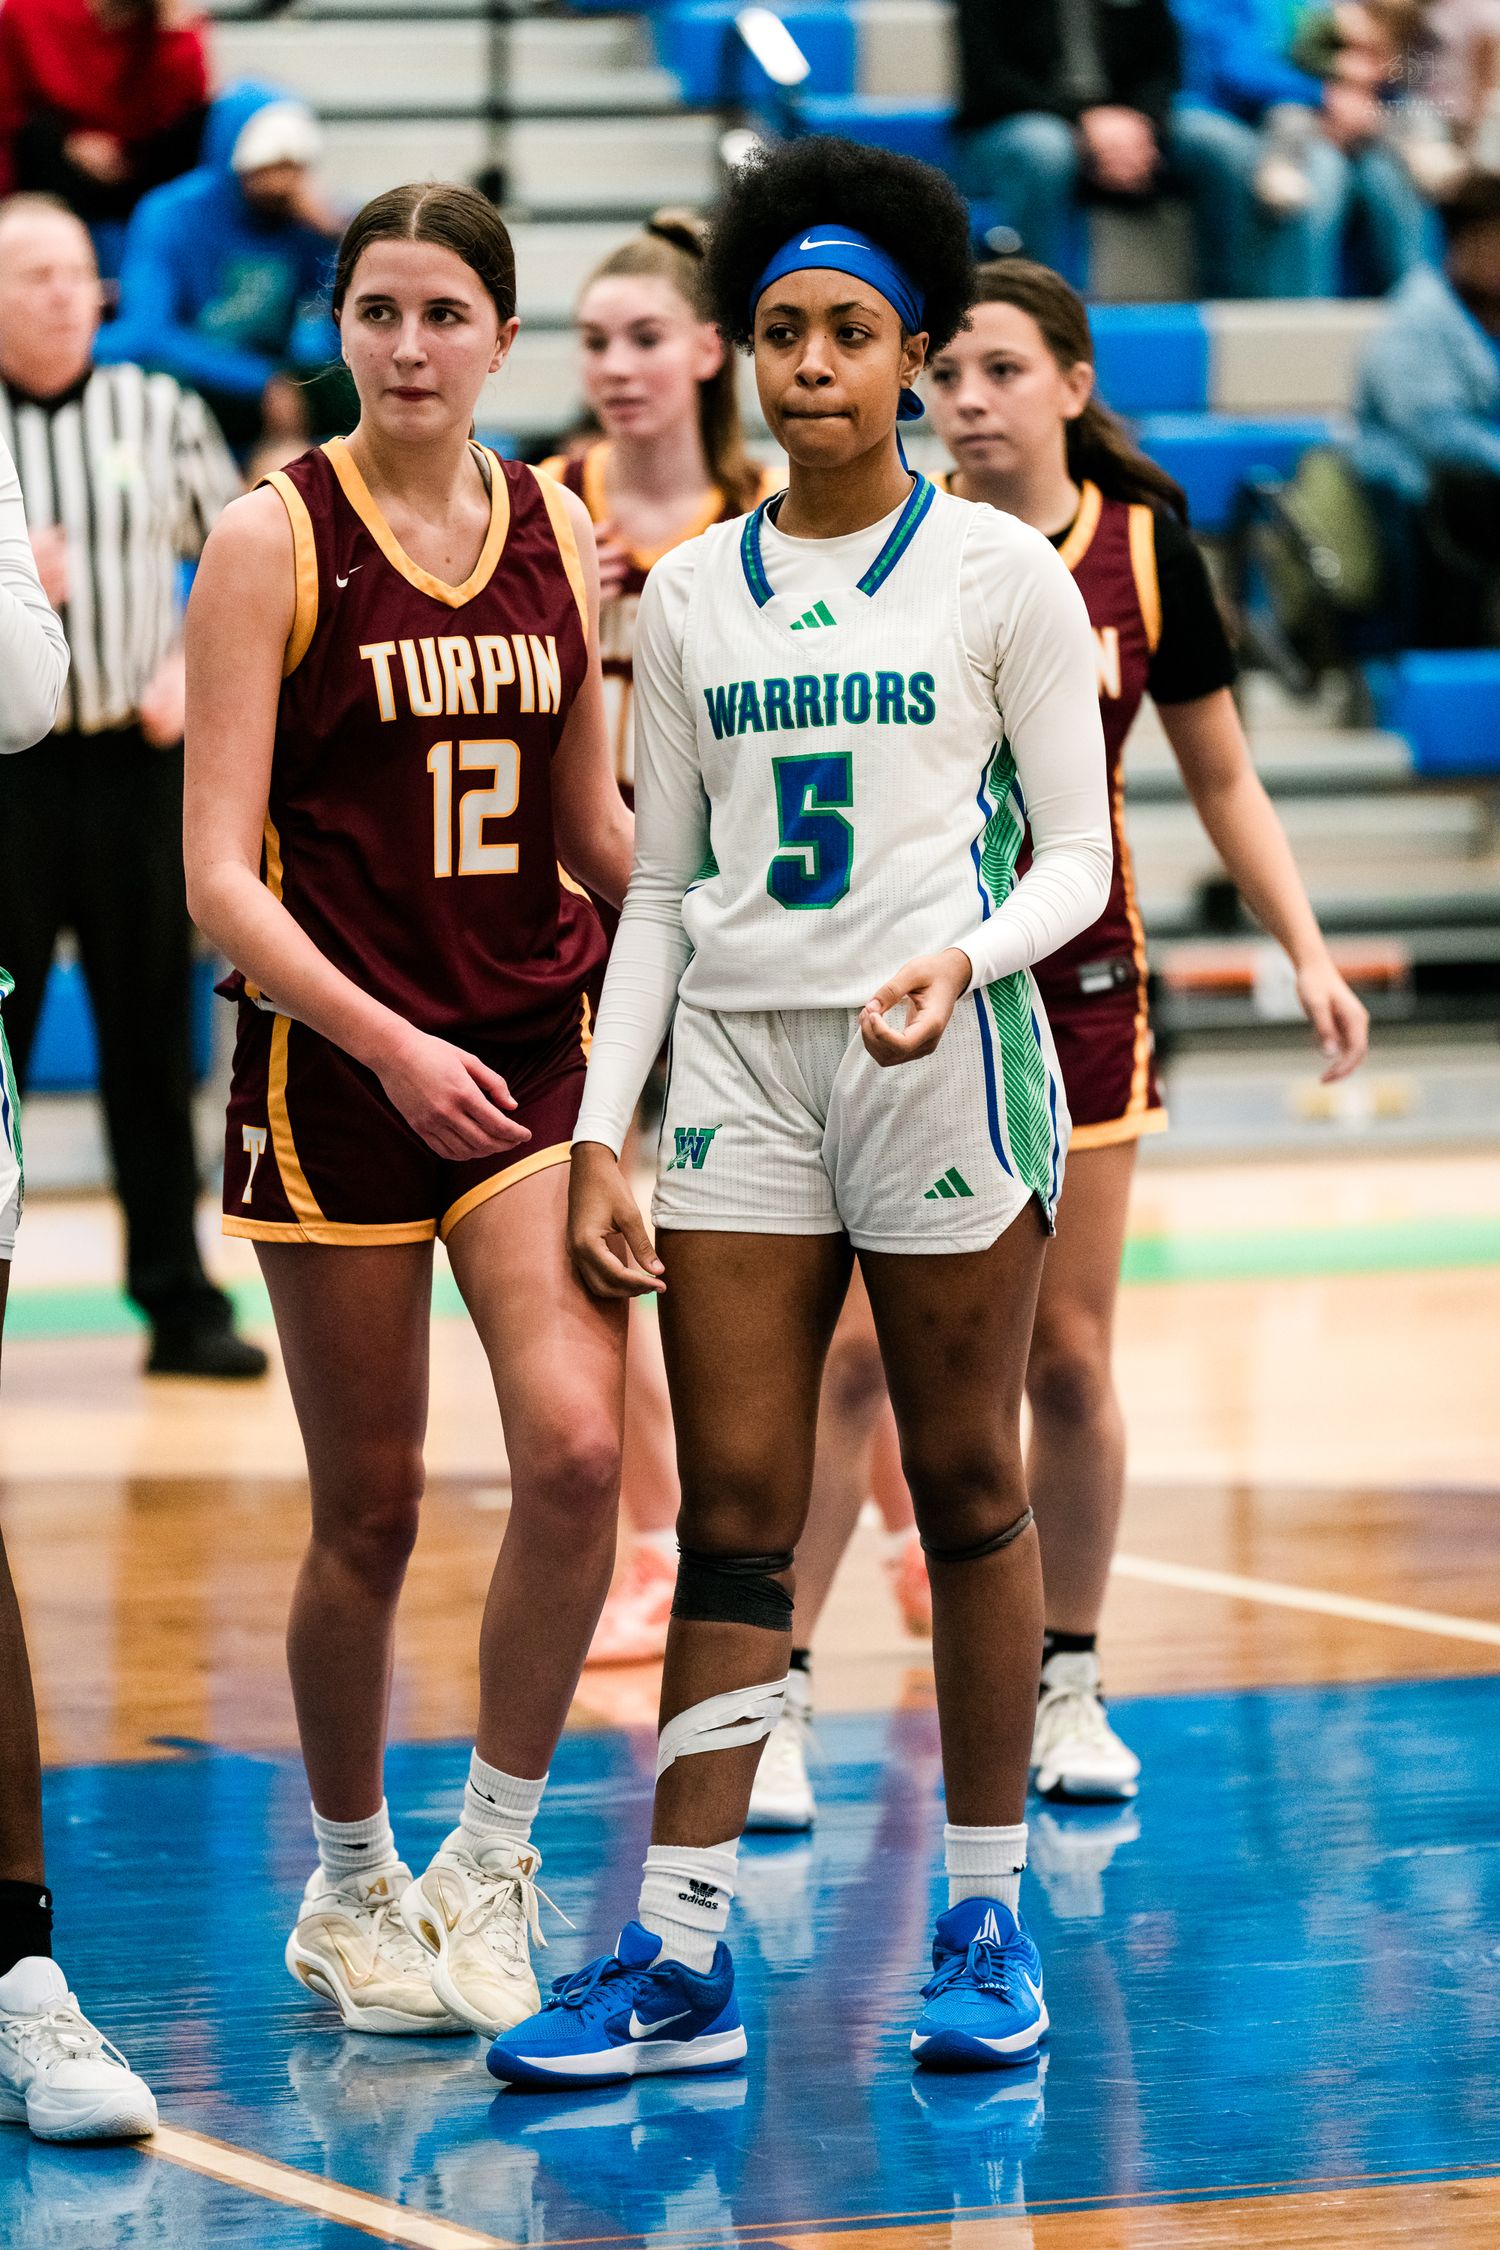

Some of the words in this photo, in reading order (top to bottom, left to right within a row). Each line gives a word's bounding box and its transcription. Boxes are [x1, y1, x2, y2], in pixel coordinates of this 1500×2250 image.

[358, 634, 562, 722] TURPIN
[703, 671, 936, 740] WARRIORS
[427, 738, 521, 878] 12
[766, 751, 854, 910] 5
[241, 1124, 267, 1204] T
[678, 1892, 719, 1910] adidas
